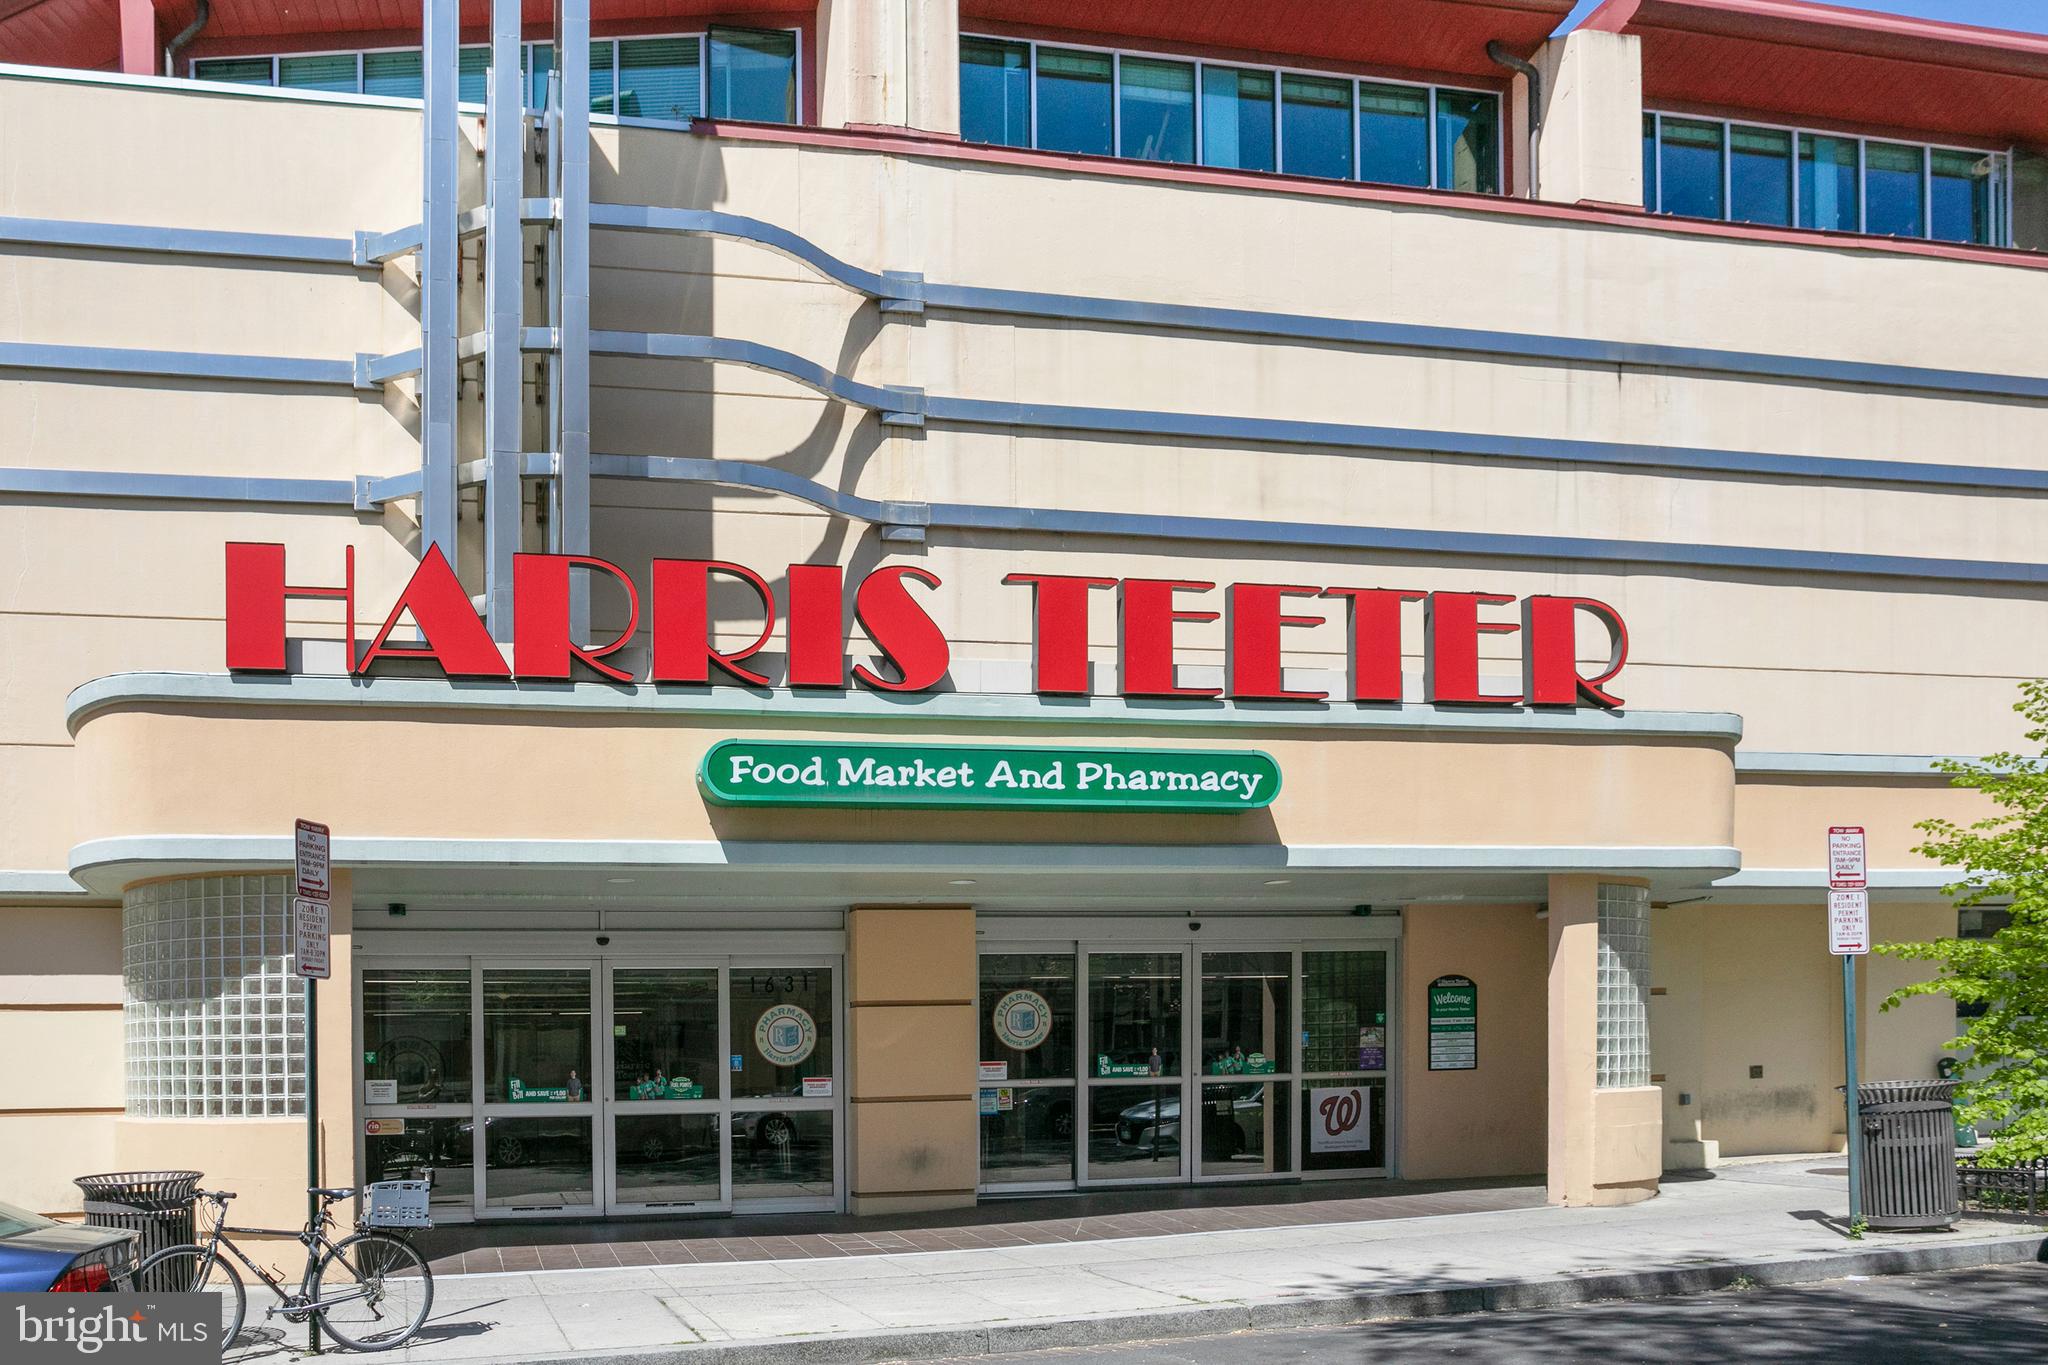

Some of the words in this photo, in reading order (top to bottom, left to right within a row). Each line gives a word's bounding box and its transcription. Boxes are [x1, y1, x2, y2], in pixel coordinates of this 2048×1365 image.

[225, 541, 950, 692] HARRIS
[1001, 573, 1629, 709] TEETER
[729, 756, 826, 786] Food
[838, 758, 974, 788] Market
[985, 760, 1066, 790] And
[1076, 762, 1263, 799] Pharmacy
[299, 841, 326, 853] PARKING
[300, 850, 326, 861] ENTRANCE
[302, 867, 319, 876] DAILY
[301, 904, 318, 914] ZONE
[299, 912, 326, 924] RESIDENT
[302, 923, 322, 932] PERMIT
[299, 930, 326, 941] PARKING
[750, 975, 808, 993] 1631
[1433, 992, 1471, 1005] Welcome
[997, 993, 1048, 1018] PHARMACY
[758, 1007, 812, 1033] PHARMACY
[1319, 1089, 1362, 1136] W
